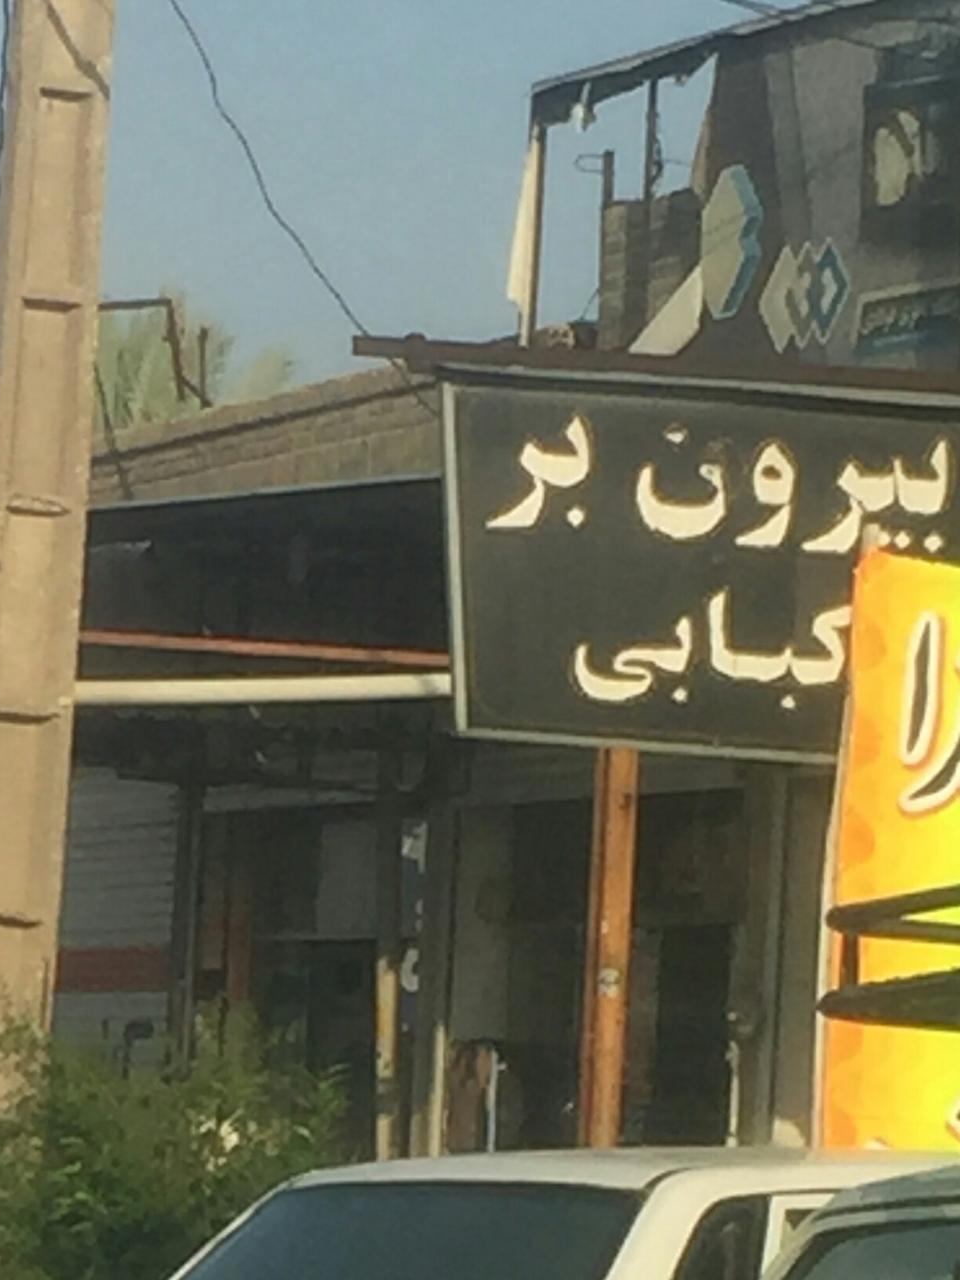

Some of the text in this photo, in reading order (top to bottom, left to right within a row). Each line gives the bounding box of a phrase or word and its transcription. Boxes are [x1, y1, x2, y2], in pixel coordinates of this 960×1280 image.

[486, 415, 948, 553] بیرون بر
[573, 586, 852, 709] کبابی
